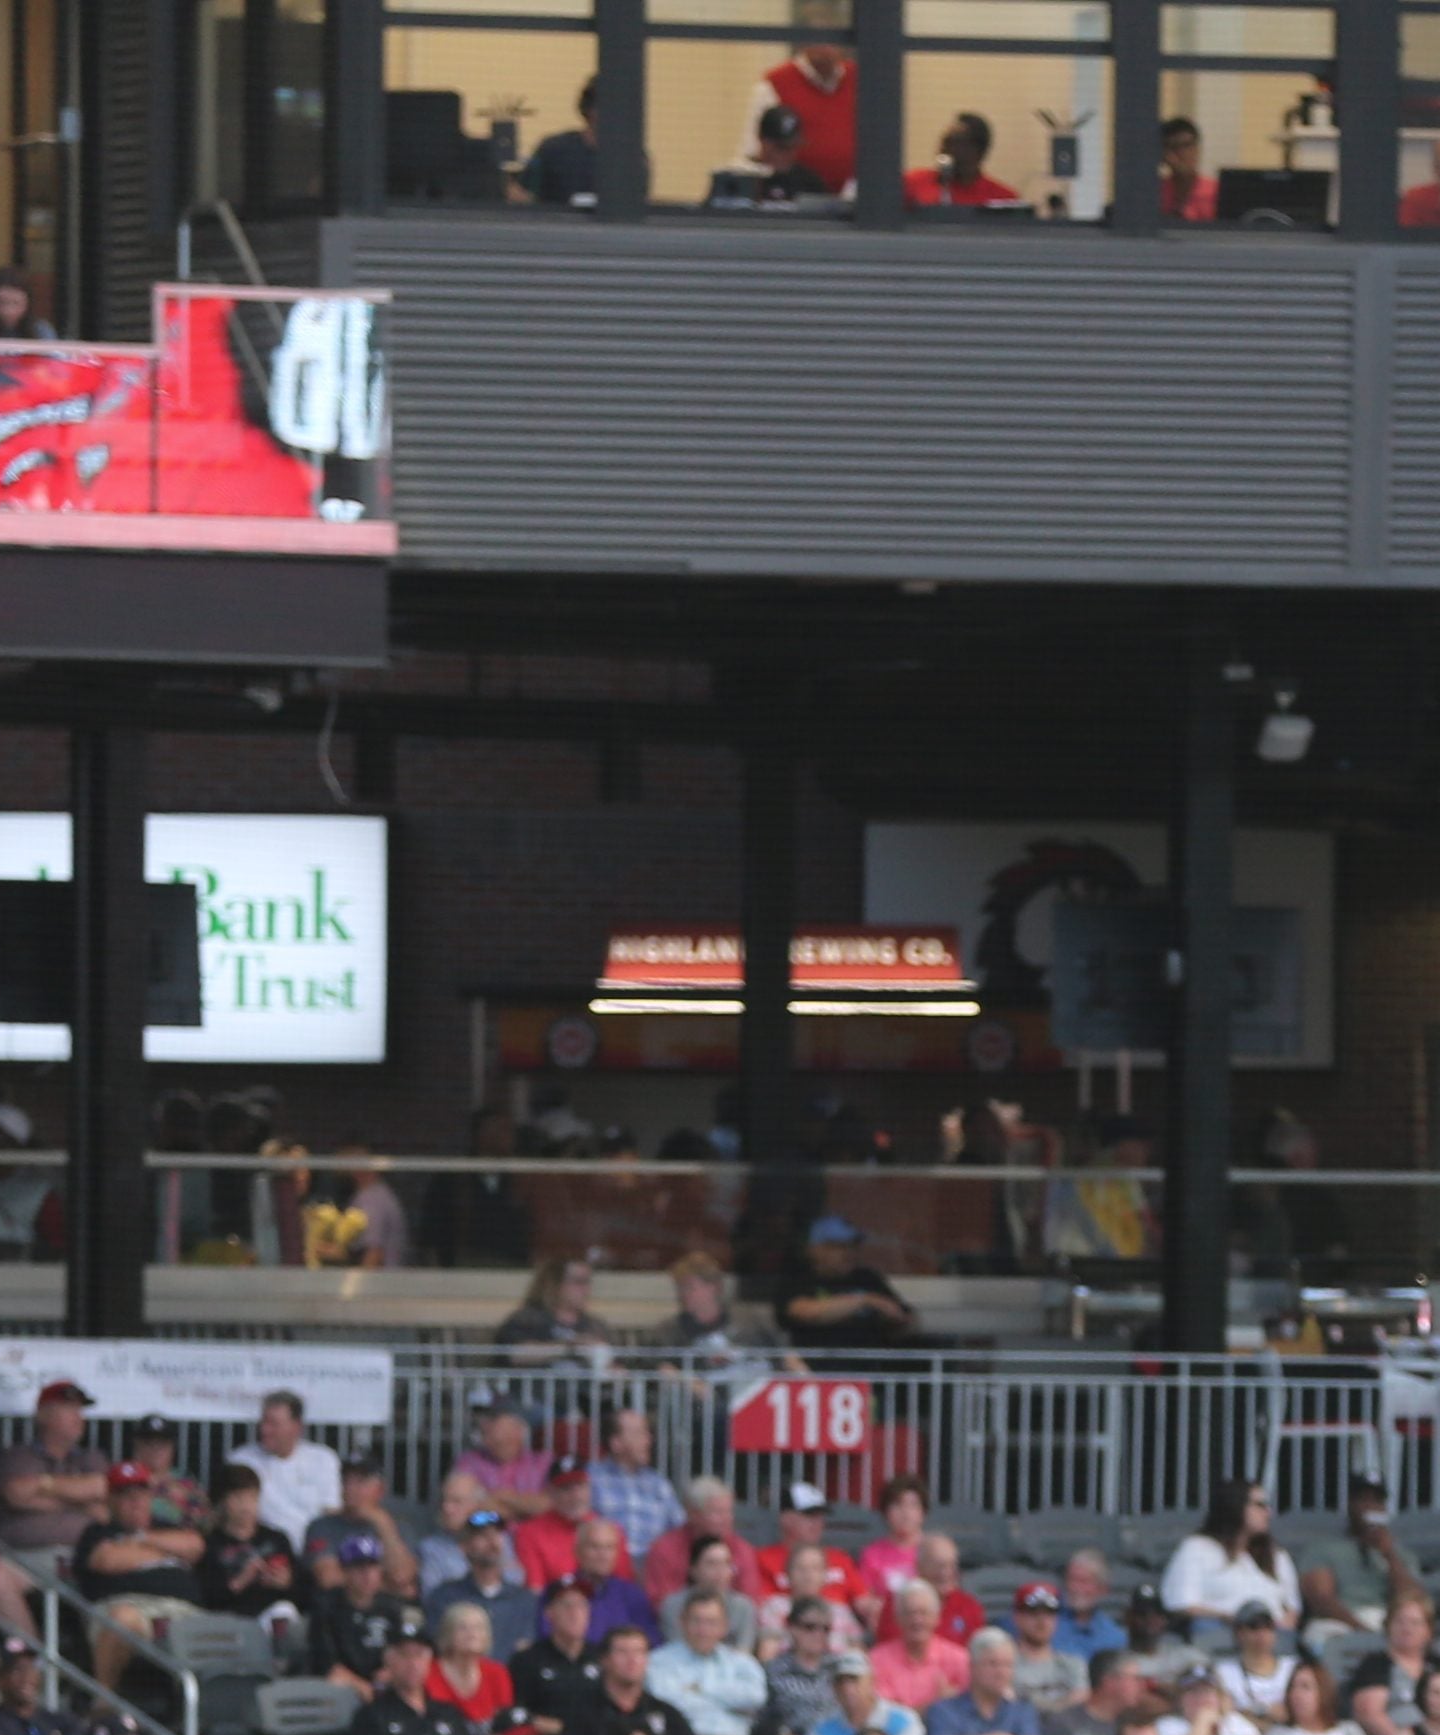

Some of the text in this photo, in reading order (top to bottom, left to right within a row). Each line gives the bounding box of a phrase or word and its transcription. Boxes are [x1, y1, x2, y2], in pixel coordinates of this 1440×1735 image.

[608, 934, 747, 964] HIGHLAN
[220, 952, 357, 1012] Trust
[766, 1382, 865, 1450] 118
